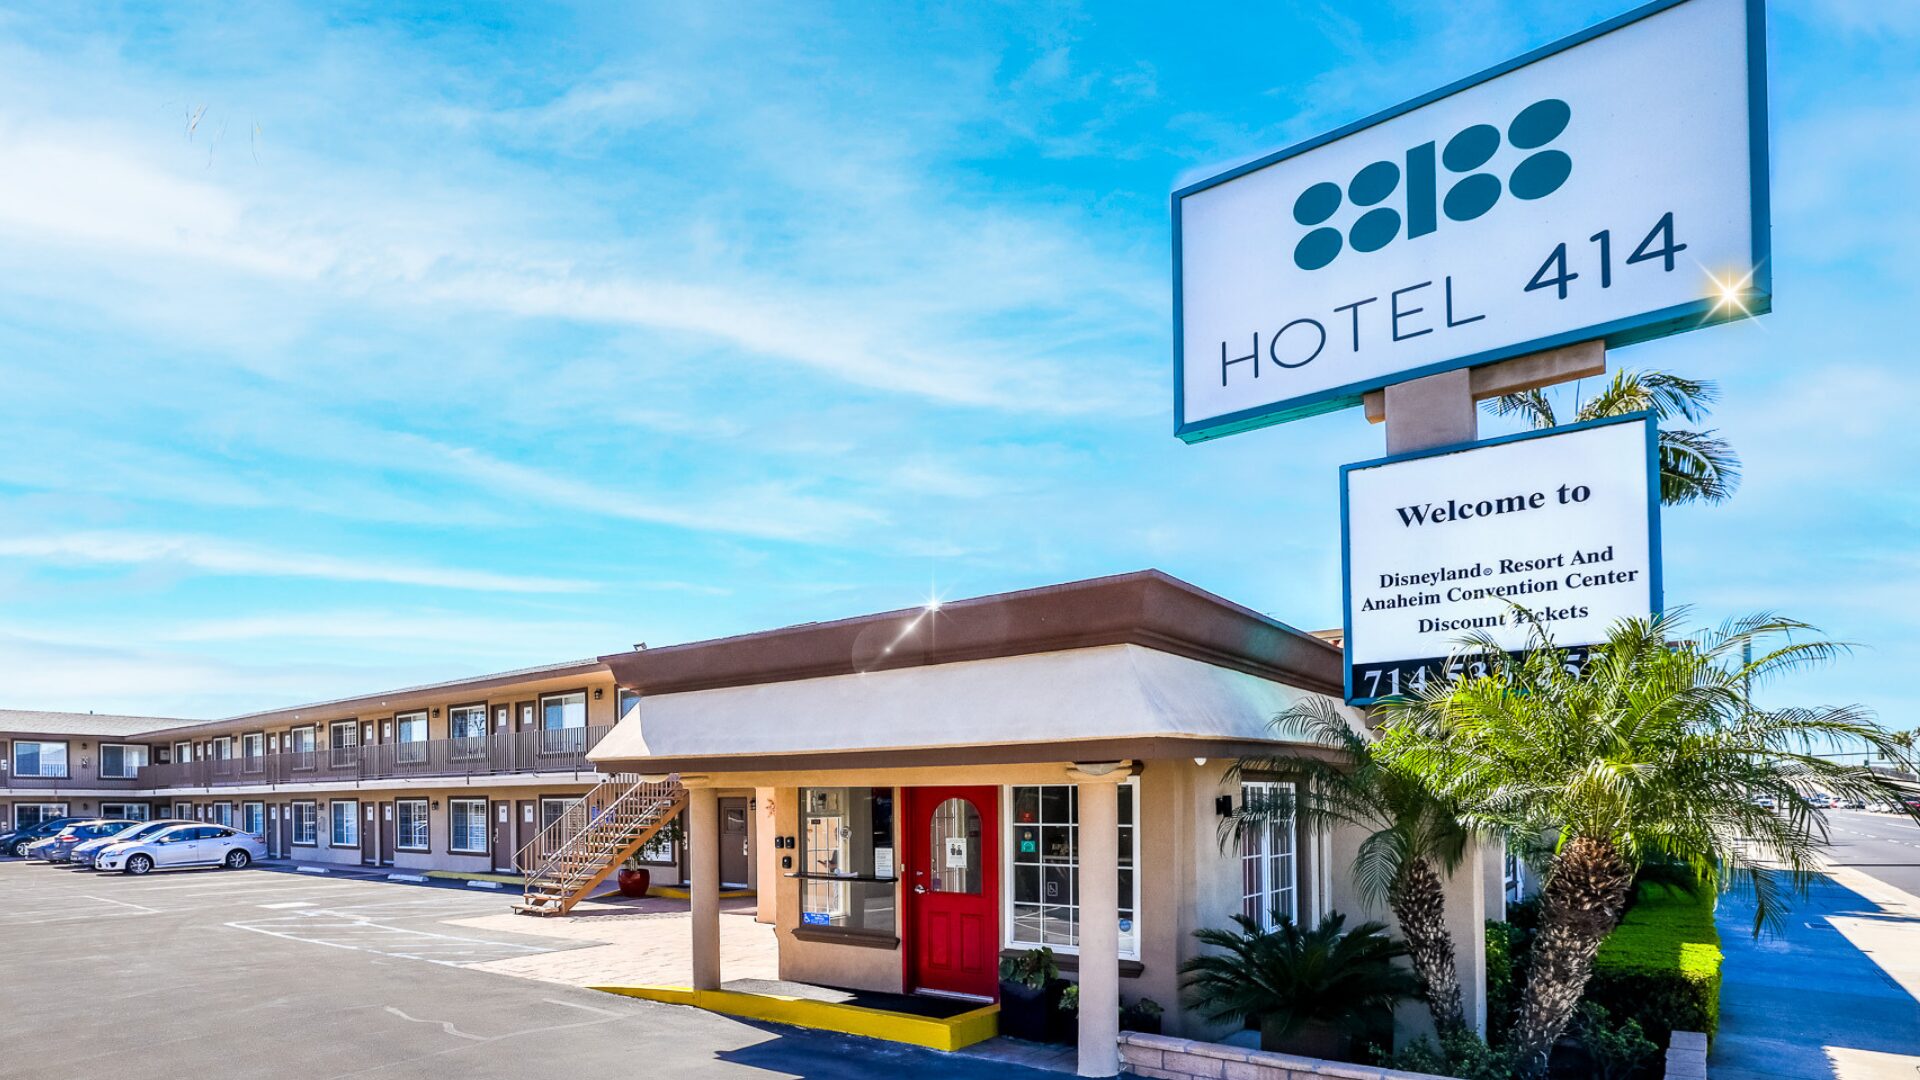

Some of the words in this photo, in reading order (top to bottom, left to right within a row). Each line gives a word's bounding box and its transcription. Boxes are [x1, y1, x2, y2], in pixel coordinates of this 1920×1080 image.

[1220, 275, 1486, 387] HOTEL
[1523, 211, 1688, 300] 414
[1396, 491, 1546, 528] Welcome
[1556, 483, 1592, 505] to
[1499, 553, 1565, 575] Resort
[1570, 545, 1614, 567] And
[1361, 590, 1441, 612] Anaheim
[1446, 578, 1558, 603] Convention
[1565, 568, 1639, 589] Center
[1418, 613, 1506, 634] Discount
[1511, 603, 1589, 625] Tickets
[1363, 665, 1428, 698] 714
